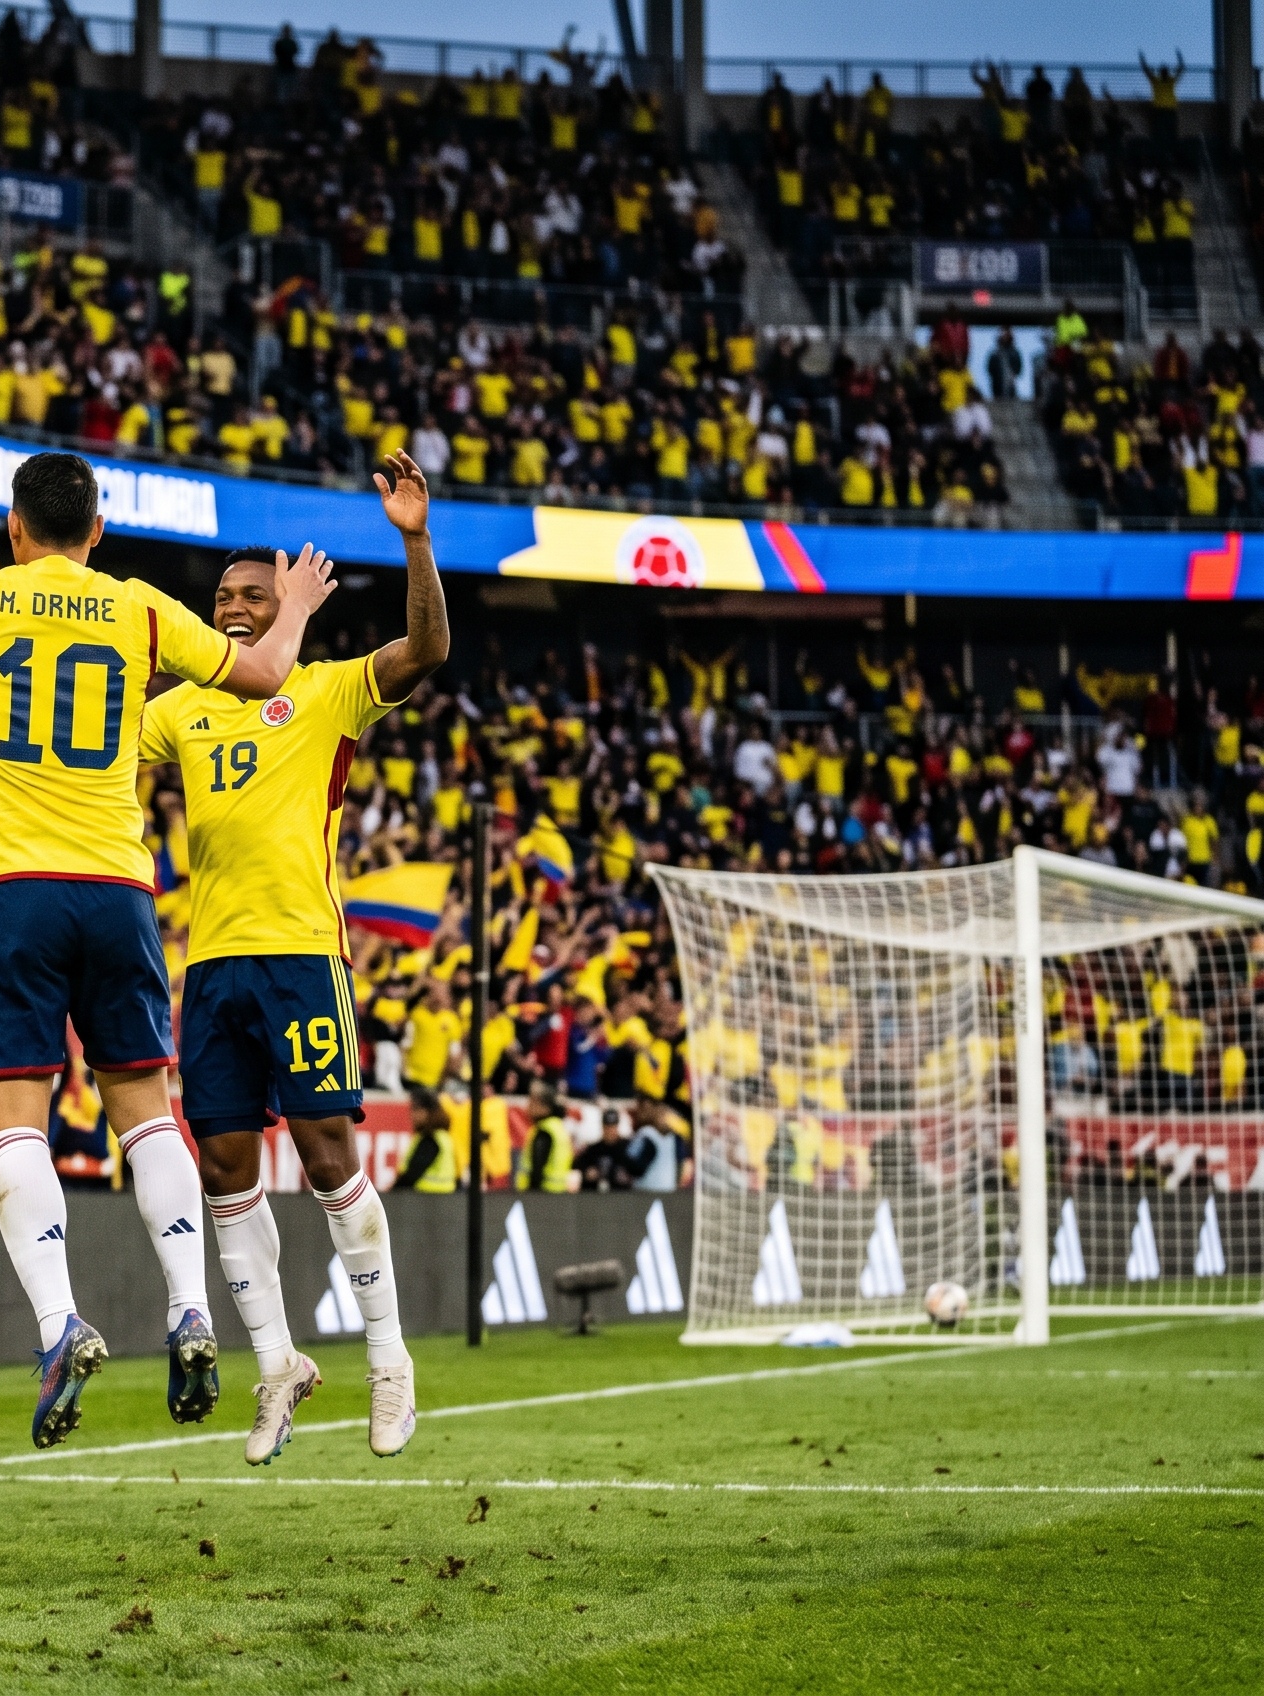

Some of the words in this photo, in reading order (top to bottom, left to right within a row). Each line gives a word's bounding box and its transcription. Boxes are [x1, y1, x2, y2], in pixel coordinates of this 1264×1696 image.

[0, 590, 21, 615] M.
[209, 741, 258, 793] 19
[284, 1016, 339, 1073] 19
[229, 1280, 250, 1293] CF
[349, 1269, 380, 1286] FCF
